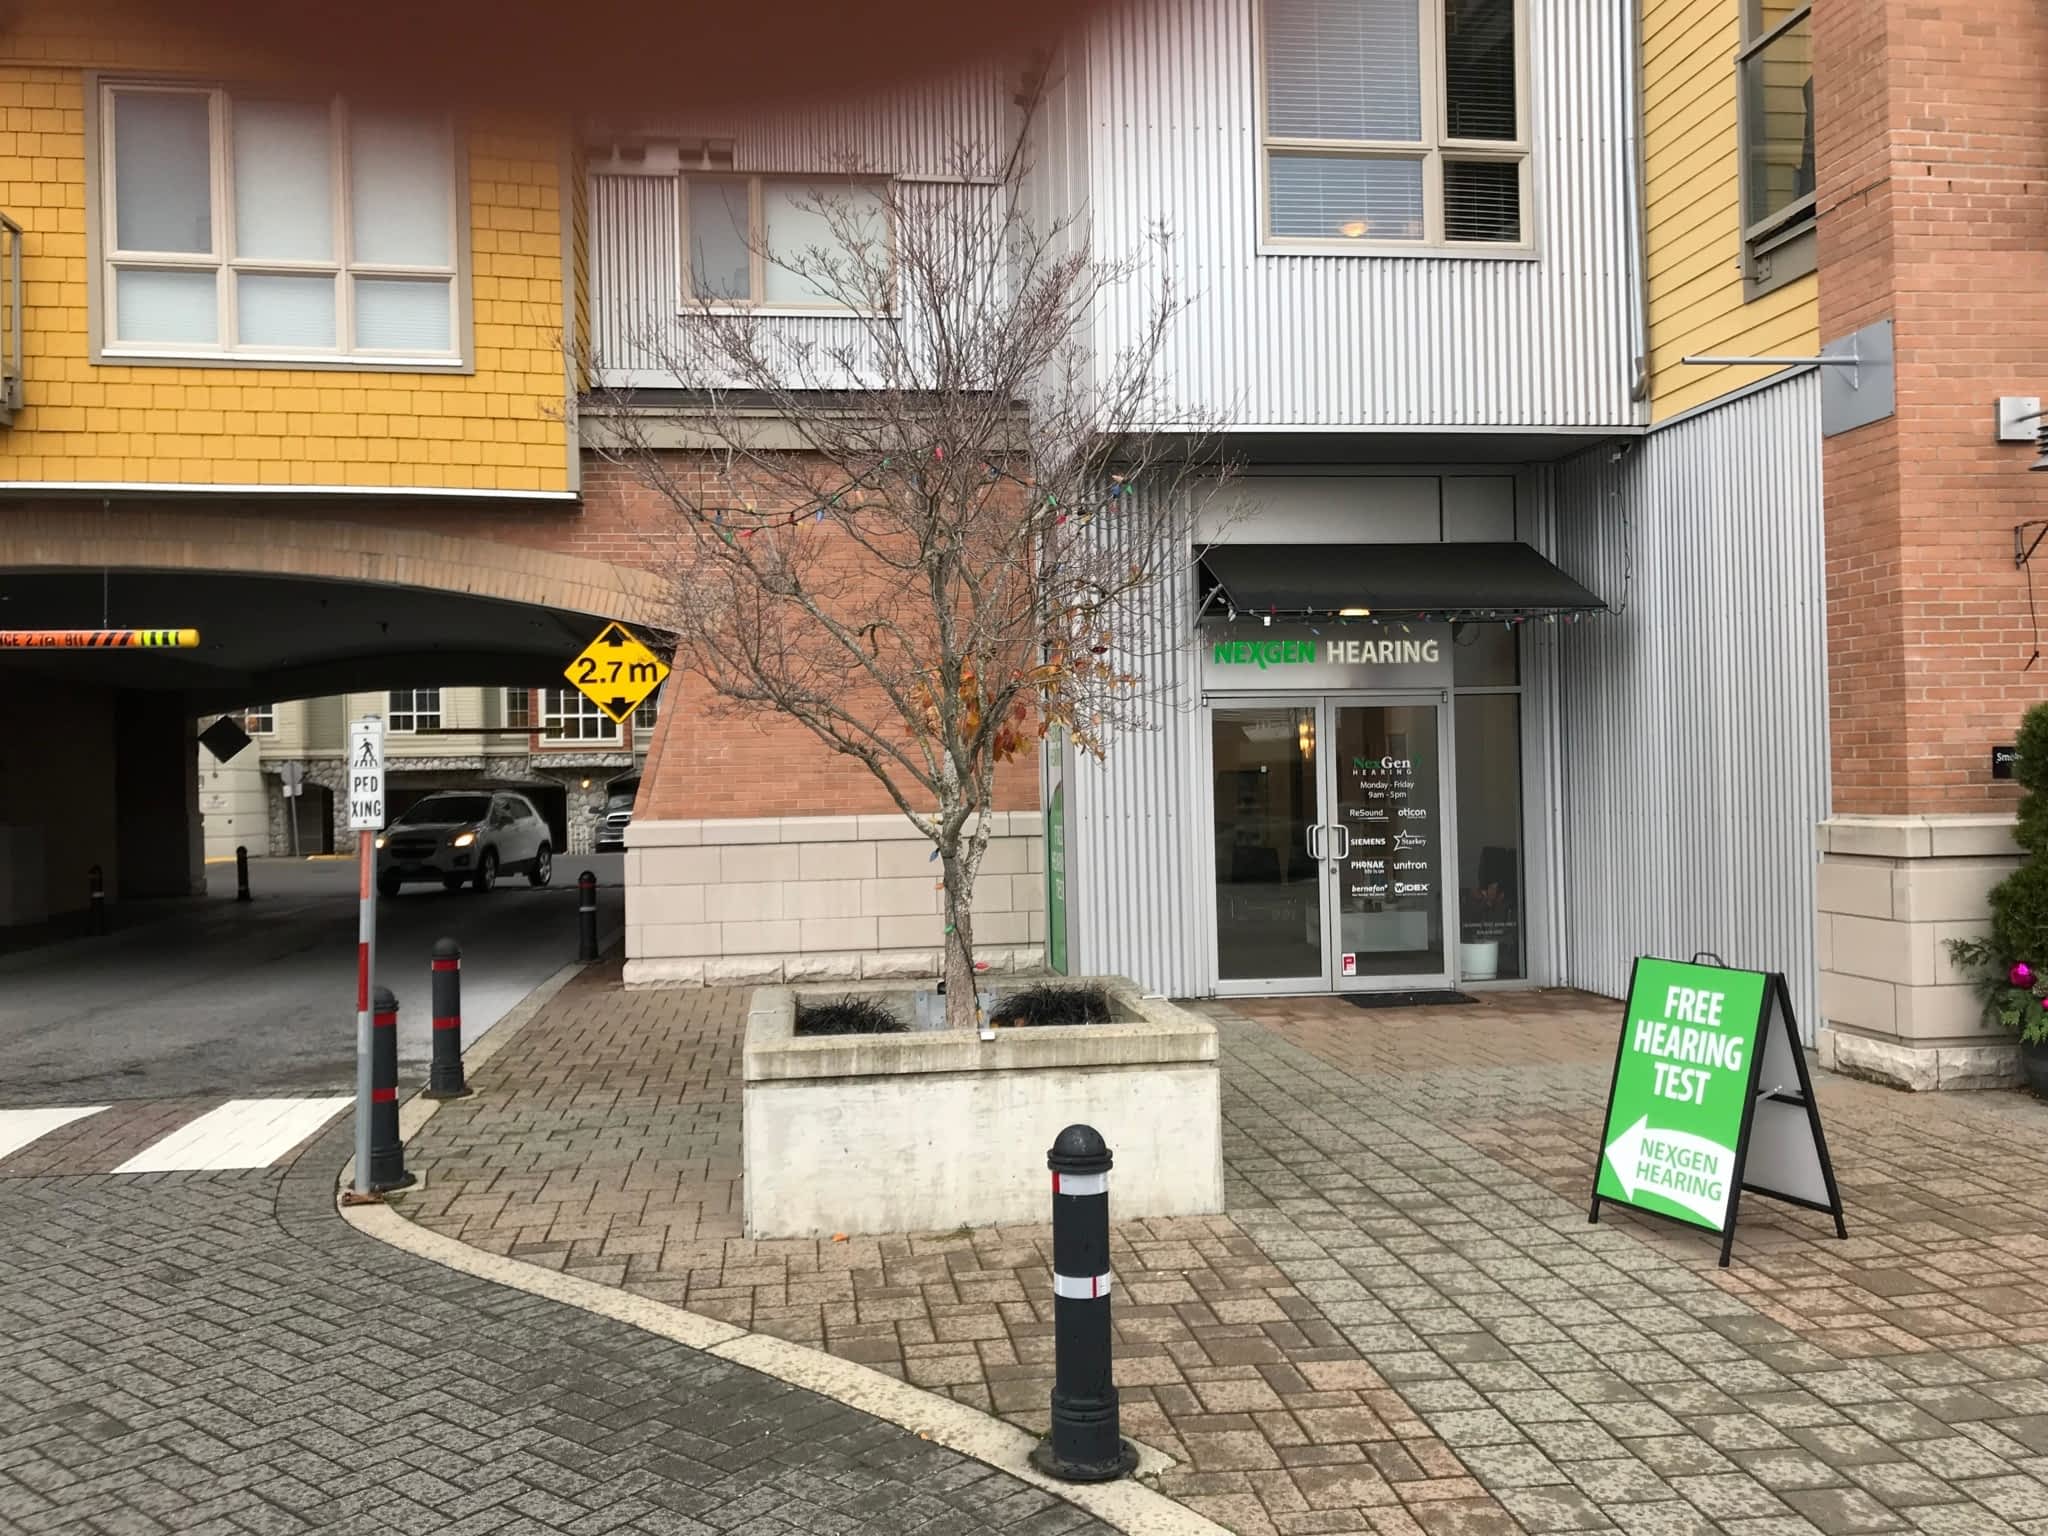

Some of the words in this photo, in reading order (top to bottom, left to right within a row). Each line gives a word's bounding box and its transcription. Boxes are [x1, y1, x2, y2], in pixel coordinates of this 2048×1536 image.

[1213, 640, 1317, 669] NEXGEN
[1326, 640, 1439, 664] HEARING
[1353, 756, 1412, 769] NexGen
[353, 776, 378, 793] PED
[1360, 781, 1388, 790] Monday
[1393, 781, 1415, 790] Friday
[1368, 791, 1385, 799] 9am
[1390, 791, 1407, 800] 5pm
[351, 800, 381, 818] XING
[1349, 809, 1384, 817] ReSound
[1397, 808, 1427, 817] oticon
[1350, 838, 1386, 846] SIEMENS
[1351, 861, 1385, 869] PHONAK
[1393, 861, 1428, 870] unitron
[1663, 985, 1725, 1027] FREE
[1633, 1019, 1744, 1071] HEARING
[1653, 1062, 1711, 1105] TEST
[1640, 1138, 1718, 1175] NEXGEN
[1635, 1164, 1722, 1201] HEARING
